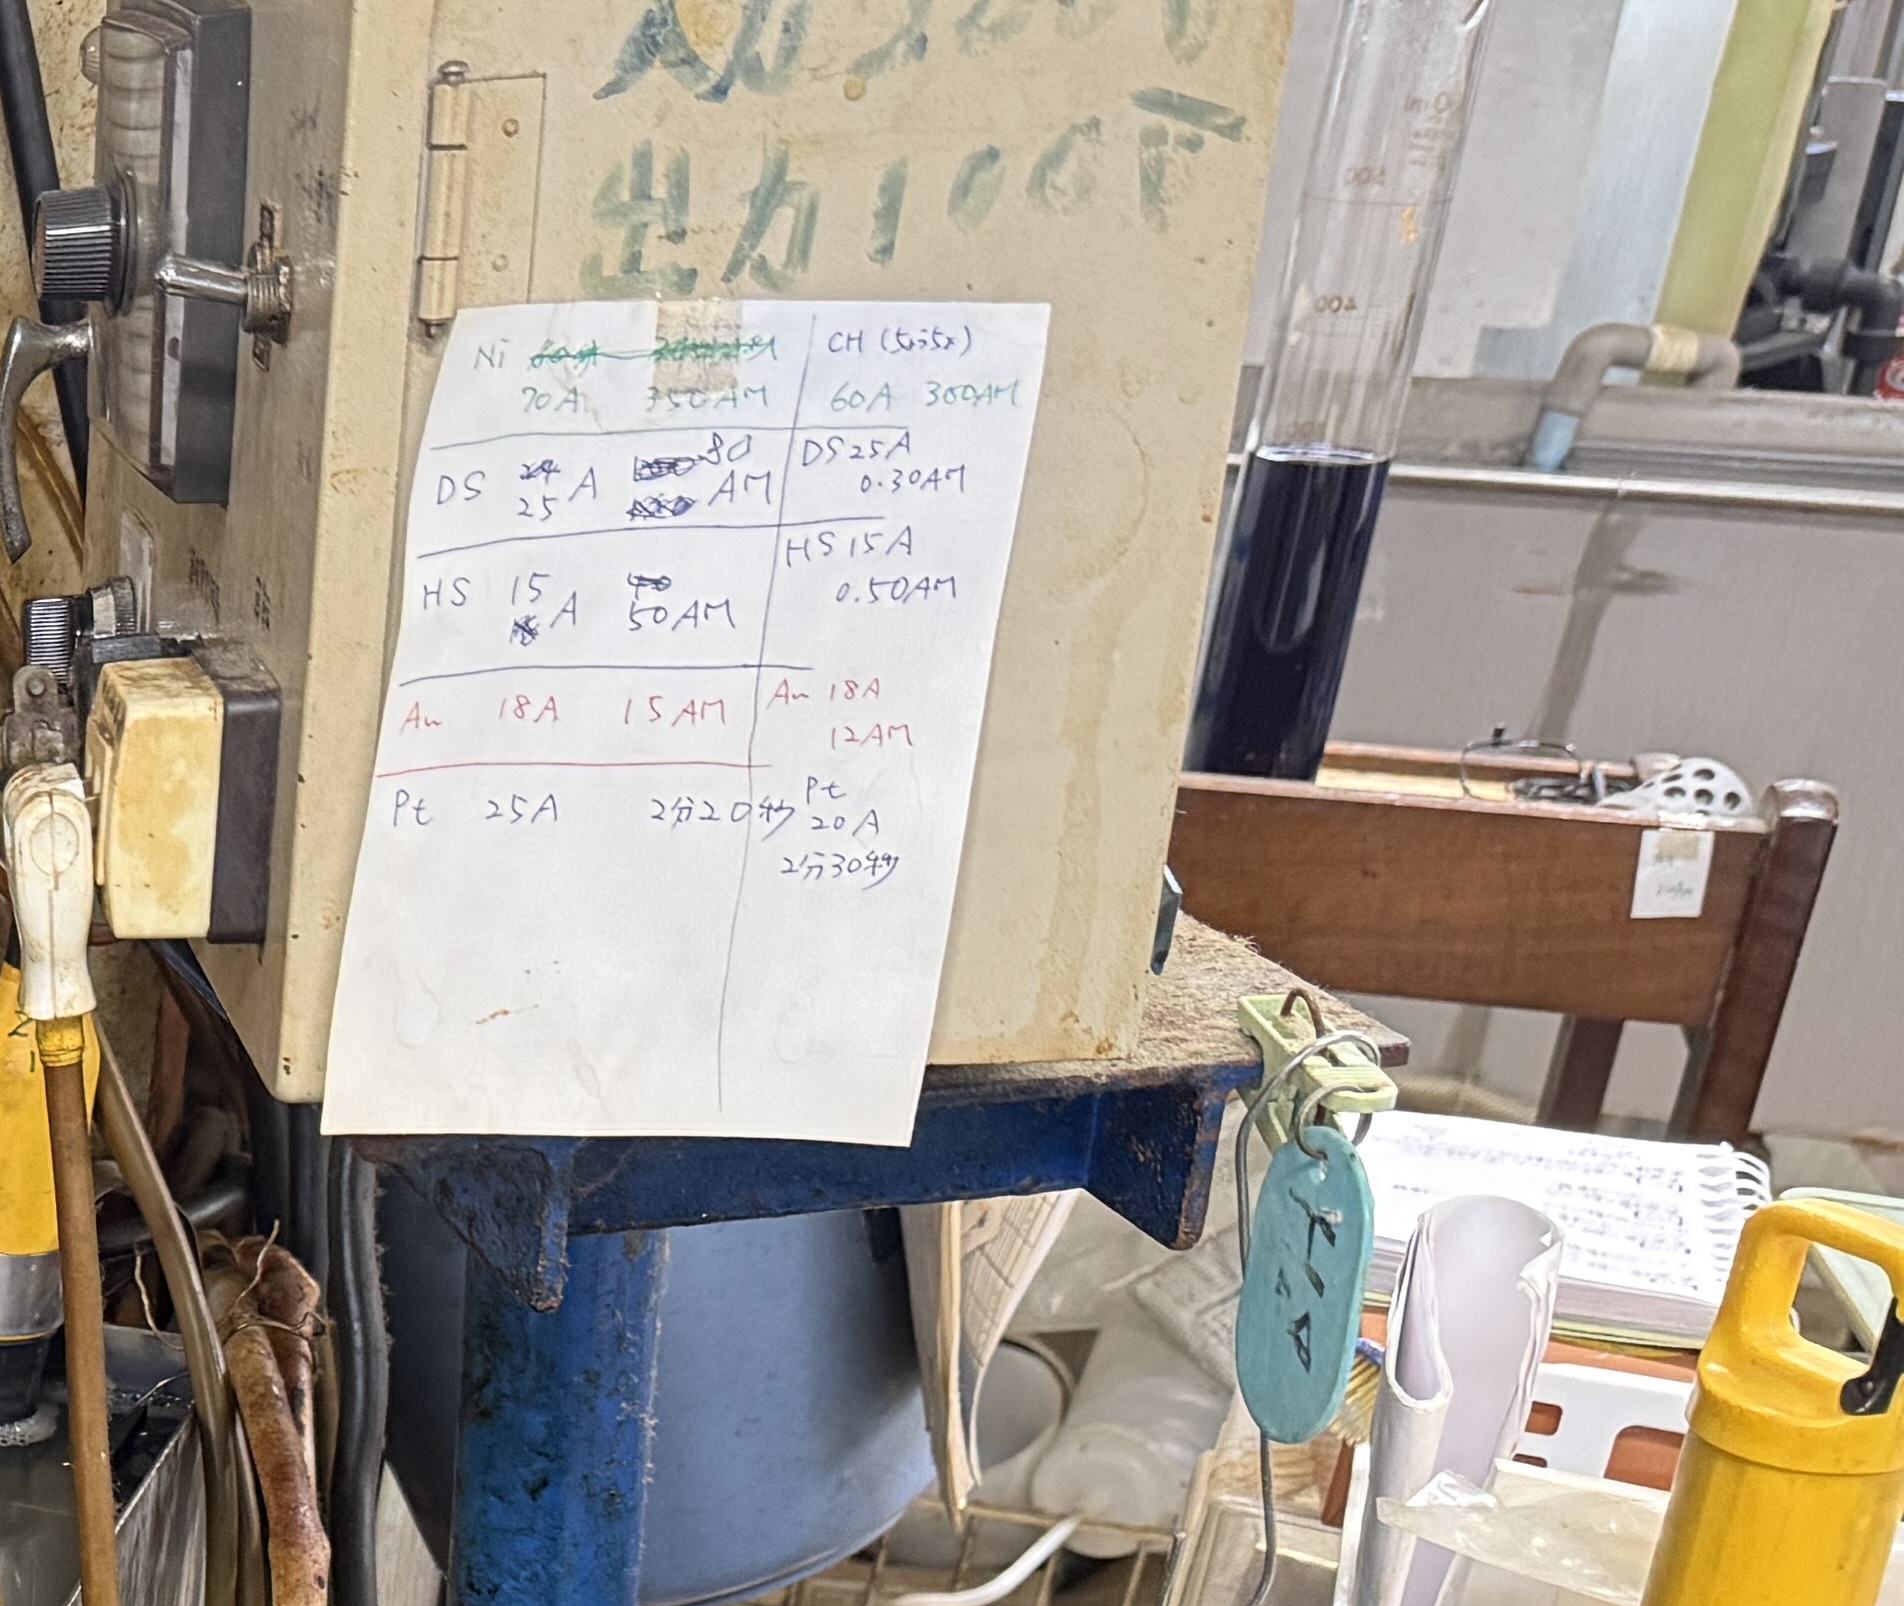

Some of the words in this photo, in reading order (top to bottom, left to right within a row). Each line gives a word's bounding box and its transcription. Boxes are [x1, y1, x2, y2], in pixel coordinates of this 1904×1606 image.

[473, 338, 508, 370] Ni
[828, 330, 864, 353] CH
[831, 381, 893, 413] 60A
[802, 436, 845, 467] DS
[849, 431, 911, 460] 25A
[436, 471, 486, 506] DS
[568, 466, 598, 502] A
[708, 469, 772, 507] AM
[518, 497, 560, 522] 25
[786, 530, 835, 567] HS
[850, 525, 913, 557] 15A
[423, 577, 471, 610] HS
[550, 591, 578, 629] A
[511, 572, 551, 605] 15
[835, 575, 957, 604] 0.50AM
[829, 678, 881, 702] 18A
[399, 701, 442, 737] Au
[499, 695, 559, 724] 18A
[831, 723, 913, 750] 12AM
[806, 776, 848, 805] Pt
[392, 788, 433, 828] Pt
[485, 793, 559, 824] 25A
[810, 809, 880, 837] 20A
[782, 850, 900, 891] 2分30秒
